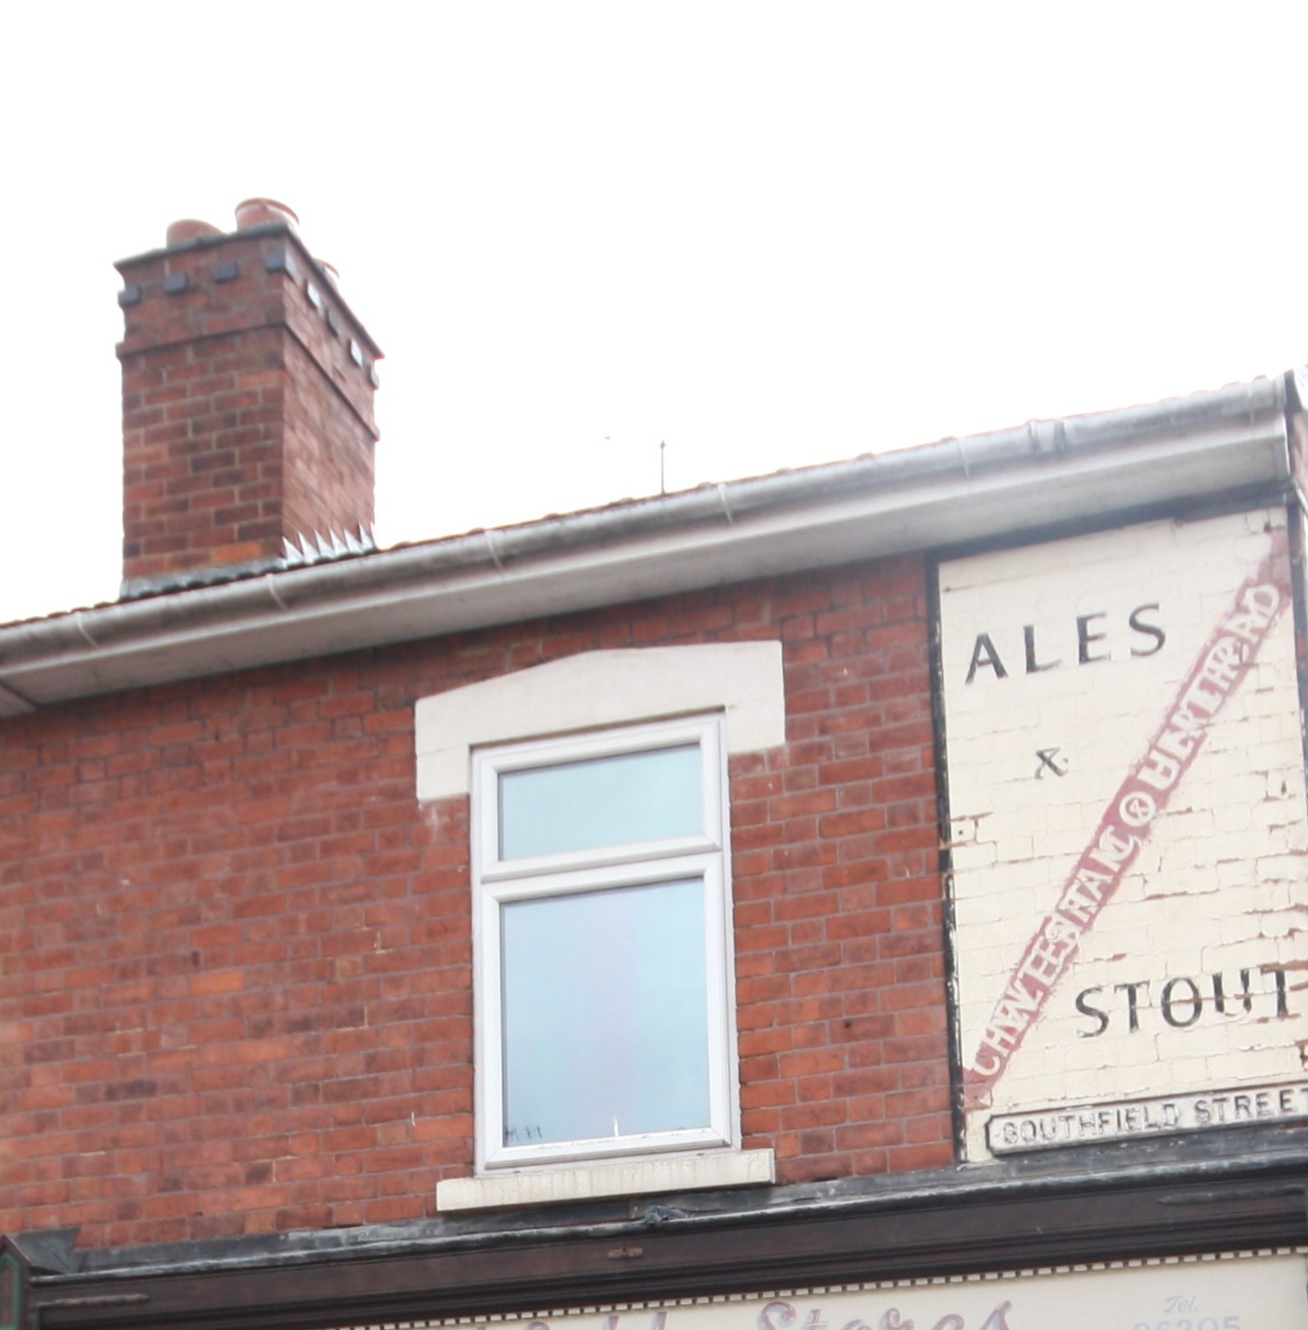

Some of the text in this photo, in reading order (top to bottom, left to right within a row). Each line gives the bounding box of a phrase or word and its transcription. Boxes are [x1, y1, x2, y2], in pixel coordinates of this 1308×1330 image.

[965, 602, 1166, 685] ALES
[1034, 747, 1069, 780] &
[1075, 966, 1294, 1038] STOUT
[1002, 1102, 1180, 1145] SOUTHFIELD
